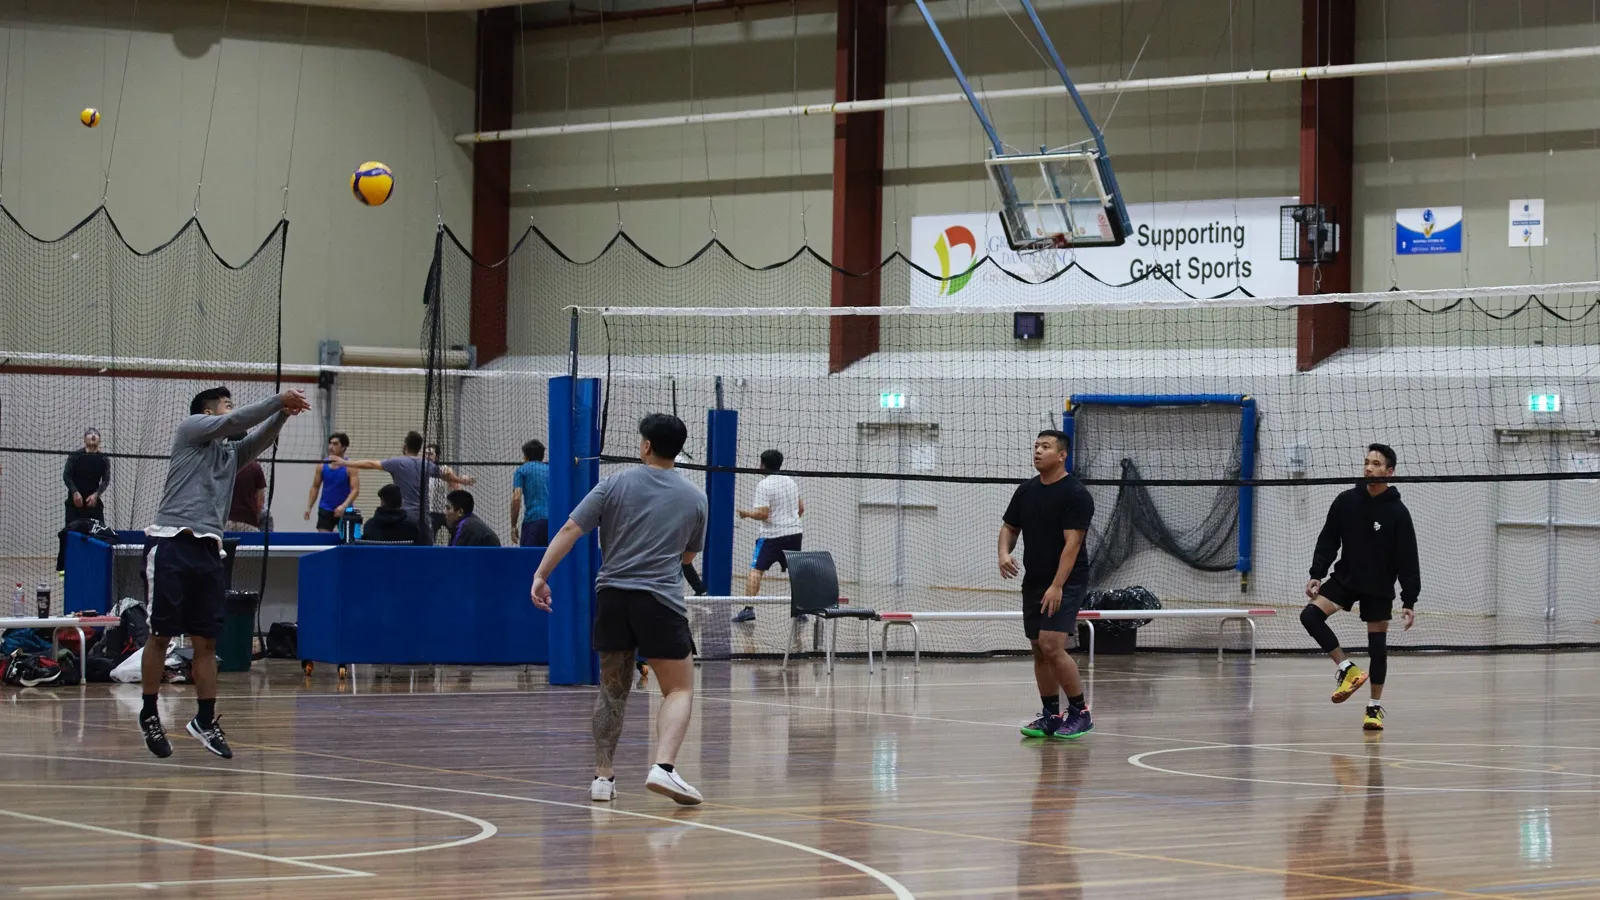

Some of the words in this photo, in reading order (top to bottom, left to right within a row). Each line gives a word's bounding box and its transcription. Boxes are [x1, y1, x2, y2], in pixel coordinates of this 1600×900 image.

[1137, 221, 1245, 251] Supporting
[1002, 248, 1076, 267] DANENNG
[1130, 258, 1181, 280] Great
[1188, 256, 1252, 285] Sports
